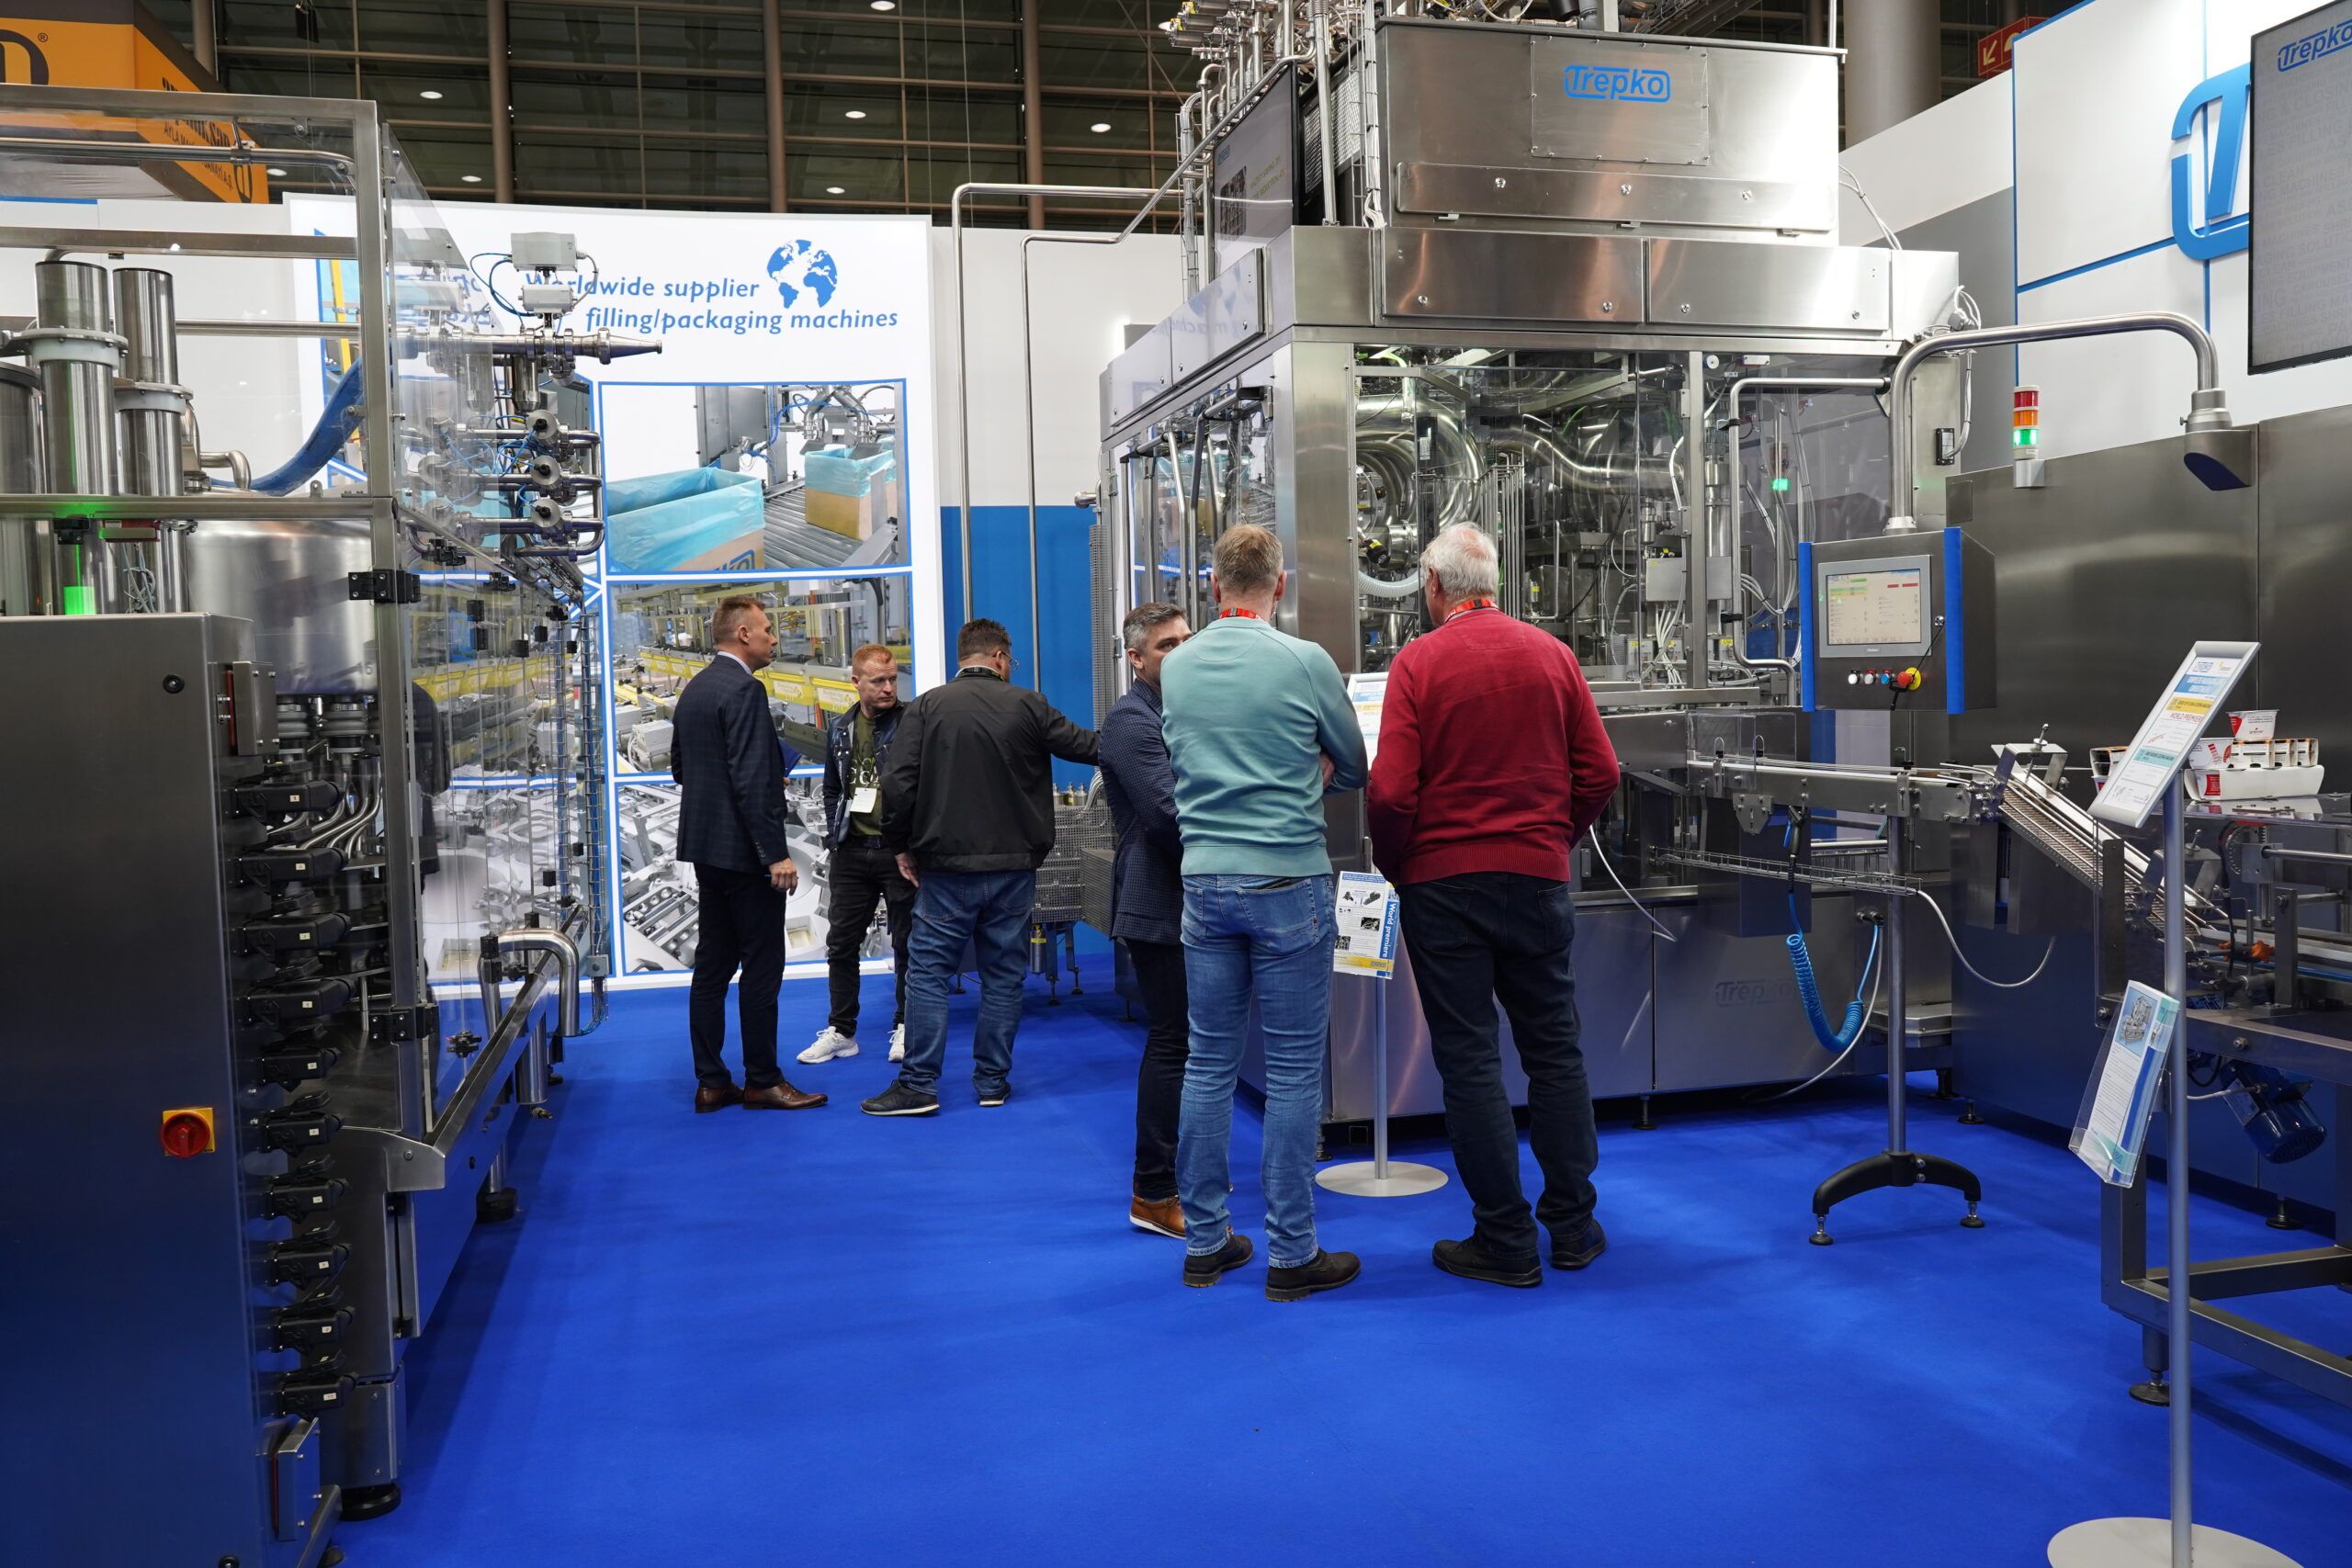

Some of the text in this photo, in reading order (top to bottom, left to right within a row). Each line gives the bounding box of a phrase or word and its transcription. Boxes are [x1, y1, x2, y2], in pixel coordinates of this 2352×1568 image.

[2278, 18, 2352, 72] Trepko
[1565, 65, 1671, 103] Trepko
[526, 273, 760, 303] Wrldwide supplier
[586, 307, 783, 335] filling/packaging
[790, 309, 899, 329] machines
[1383, 903, 1396, 957] World premiere
